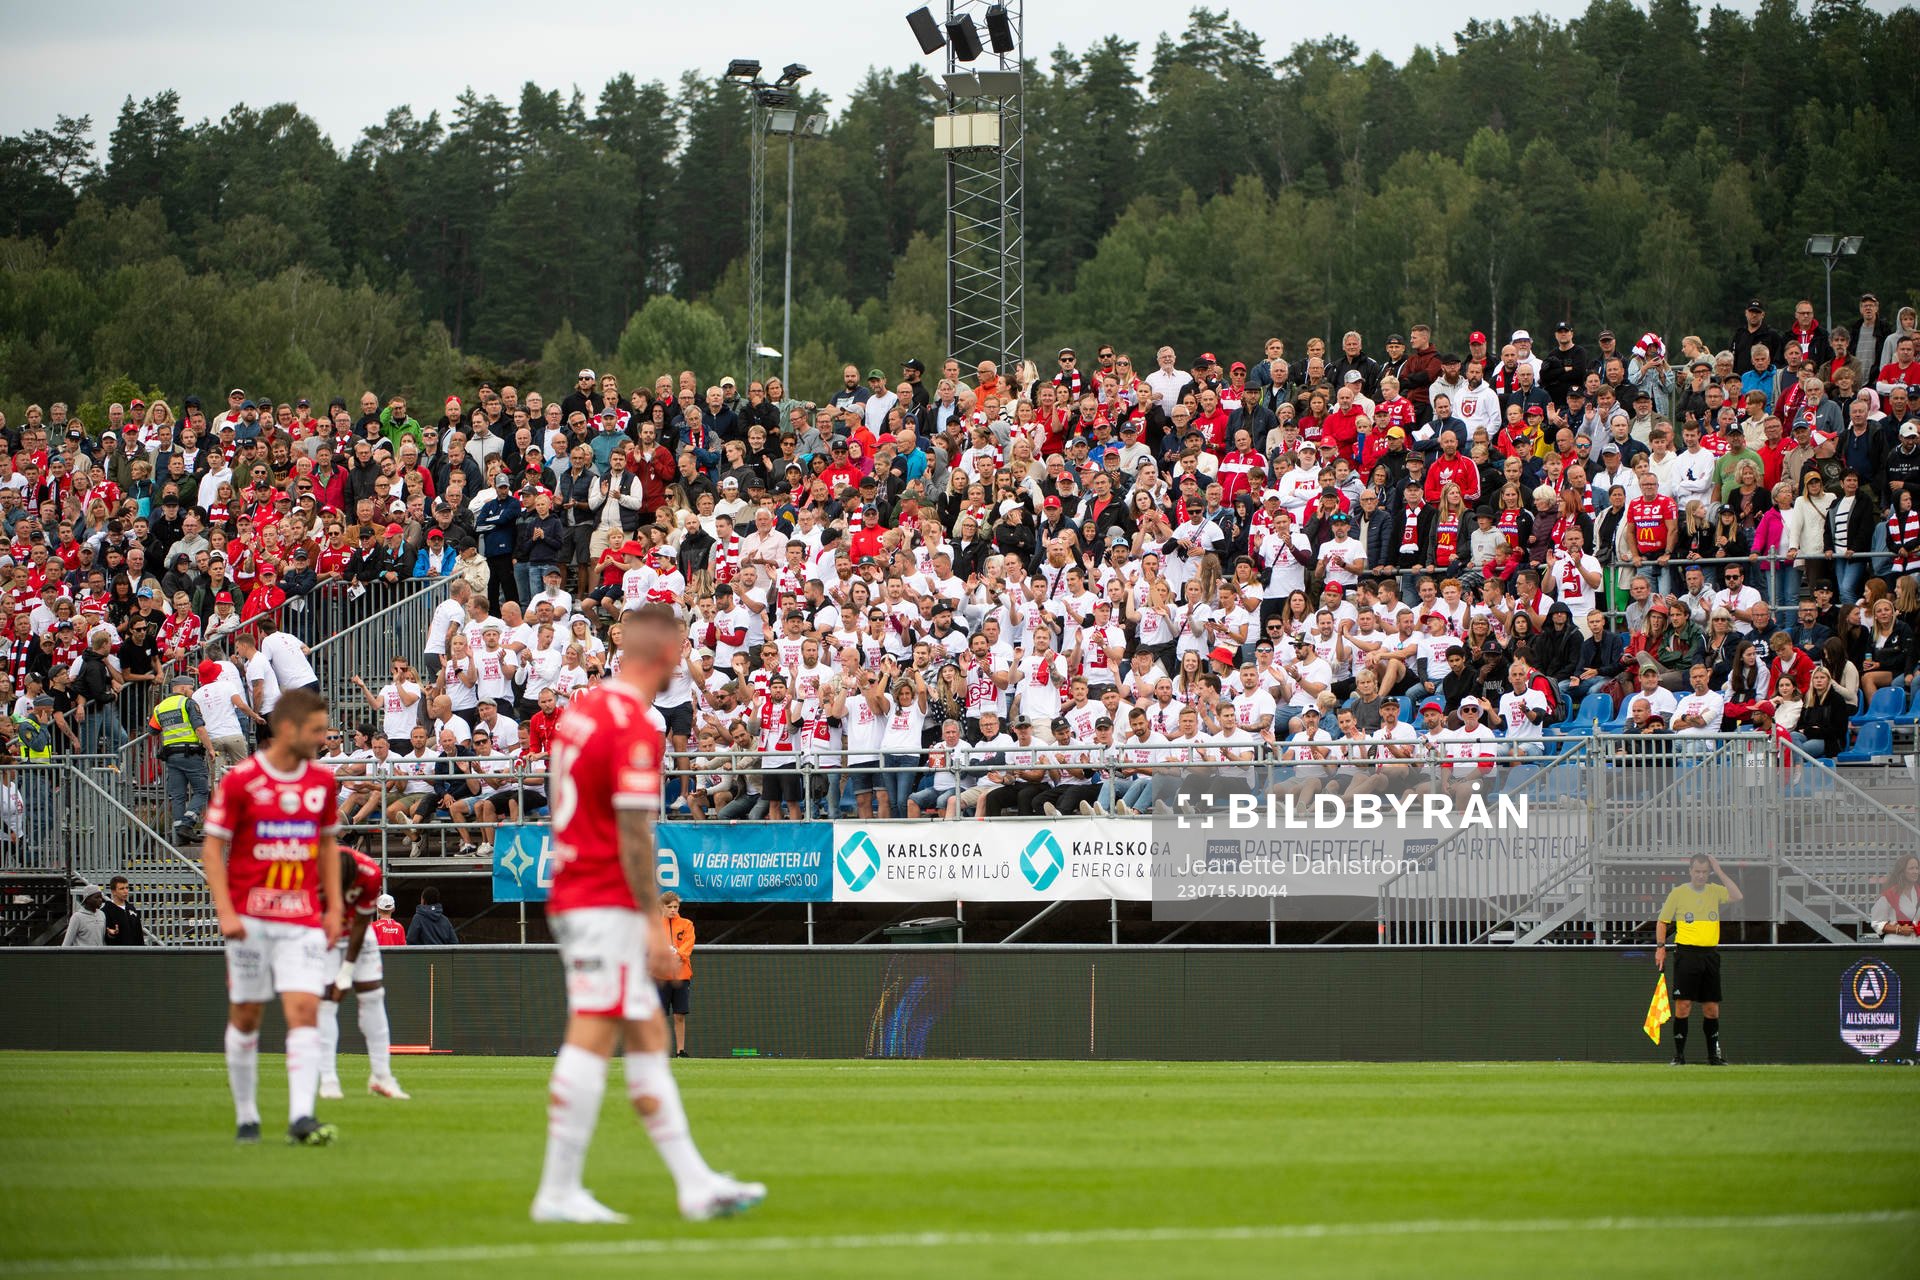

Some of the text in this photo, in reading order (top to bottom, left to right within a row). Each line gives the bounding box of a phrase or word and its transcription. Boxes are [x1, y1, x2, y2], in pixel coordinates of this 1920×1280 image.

[887, 843, 983, 858] KARLSKOGA
[1073, 841, 1171, 856] KARLSKOGA
[1246, 840, 1384, 862] PARTNERTECH
[693, 852, 821, 869] VI GER FASTIGHETER LIV
[887, 861, 1010, 879] ENERGI & MILJÖ
[1072, 863, 1130, 878] ENERGI
[1136, 863, 1145, 878] &
[730, 874, 753, 888] VENT
[1846, 1012, 1895, 1025] ALLSVENSKAN
